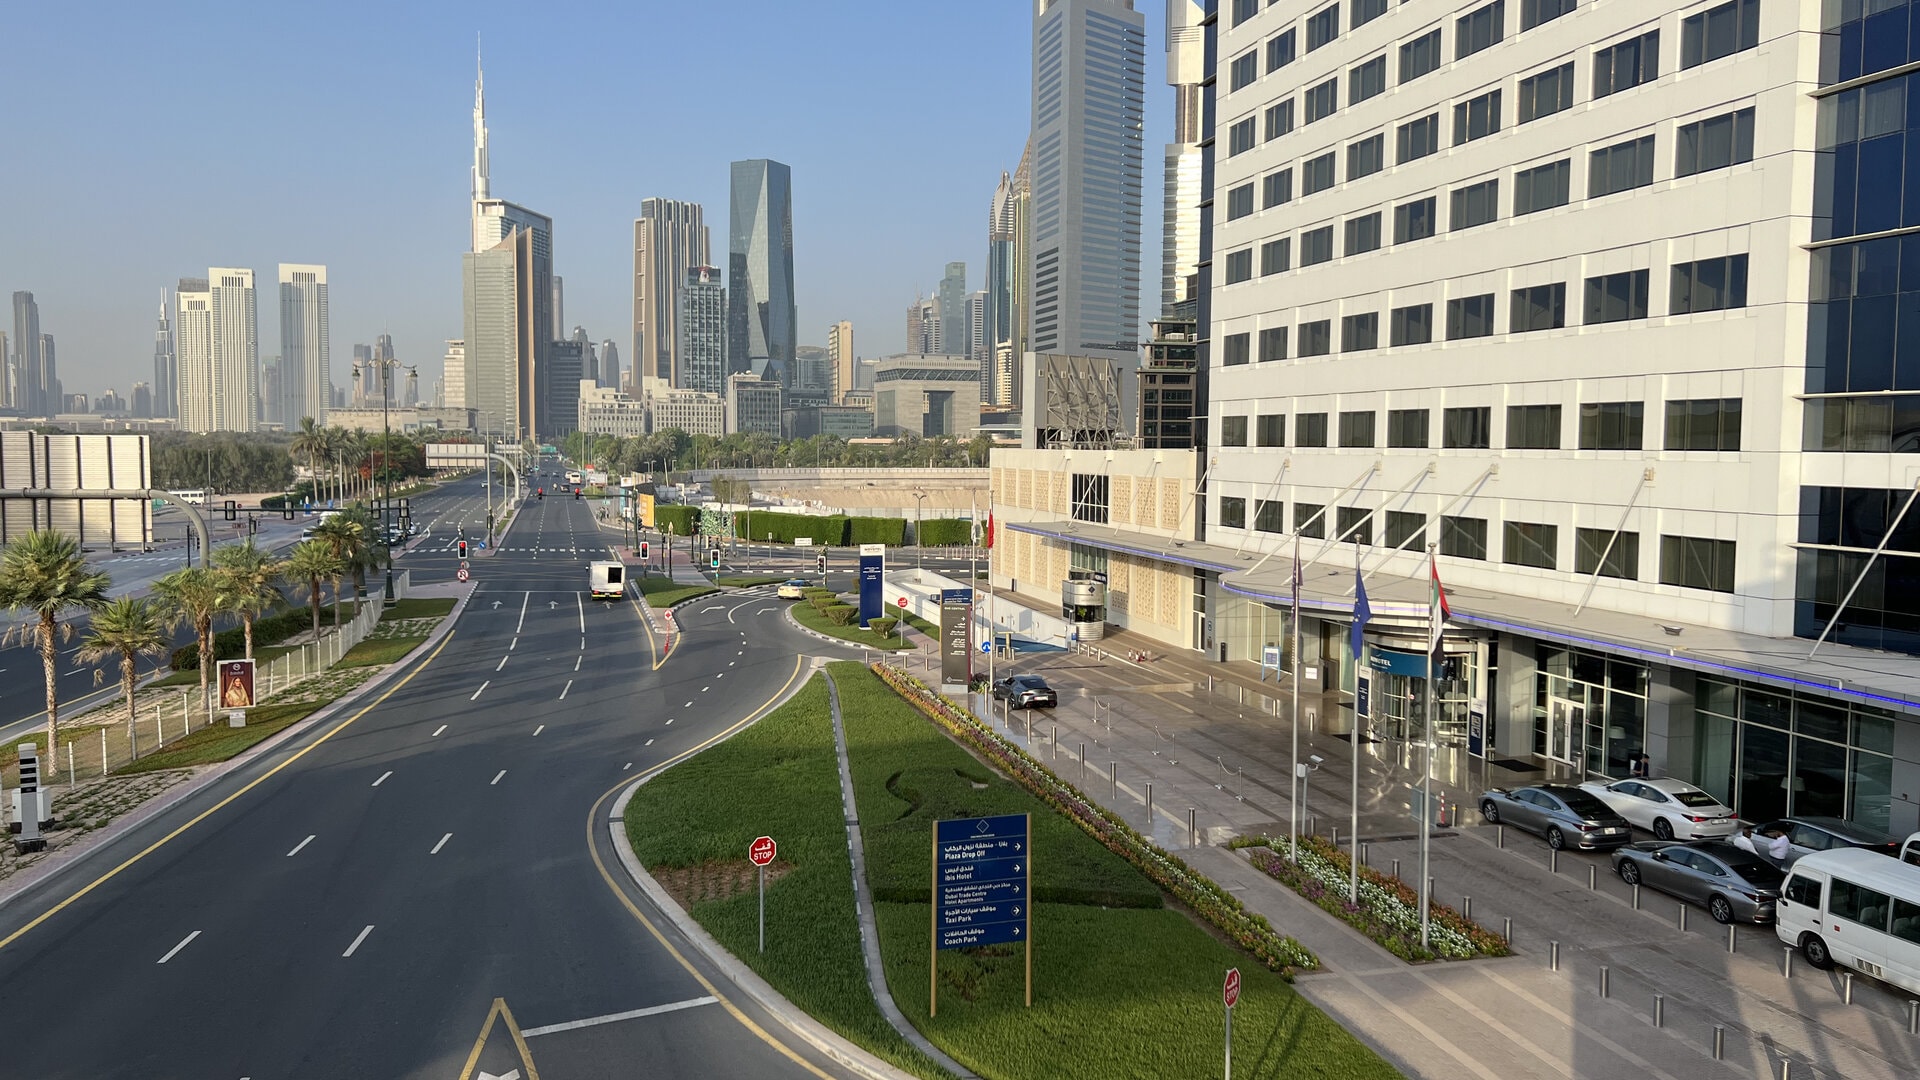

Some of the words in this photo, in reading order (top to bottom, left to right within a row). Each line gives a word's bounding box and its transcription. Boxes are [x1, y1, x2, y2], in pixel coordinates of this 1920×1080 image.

[755, 840, 771, 851] قف
[945, 845, 962, 853] الركاب
[753, 851, 772, 861] STOP
[962, 851, 976, 859] Drop
[945, 930, 967, 938] الحافلات
[945, 937, 962, 945] Coach
